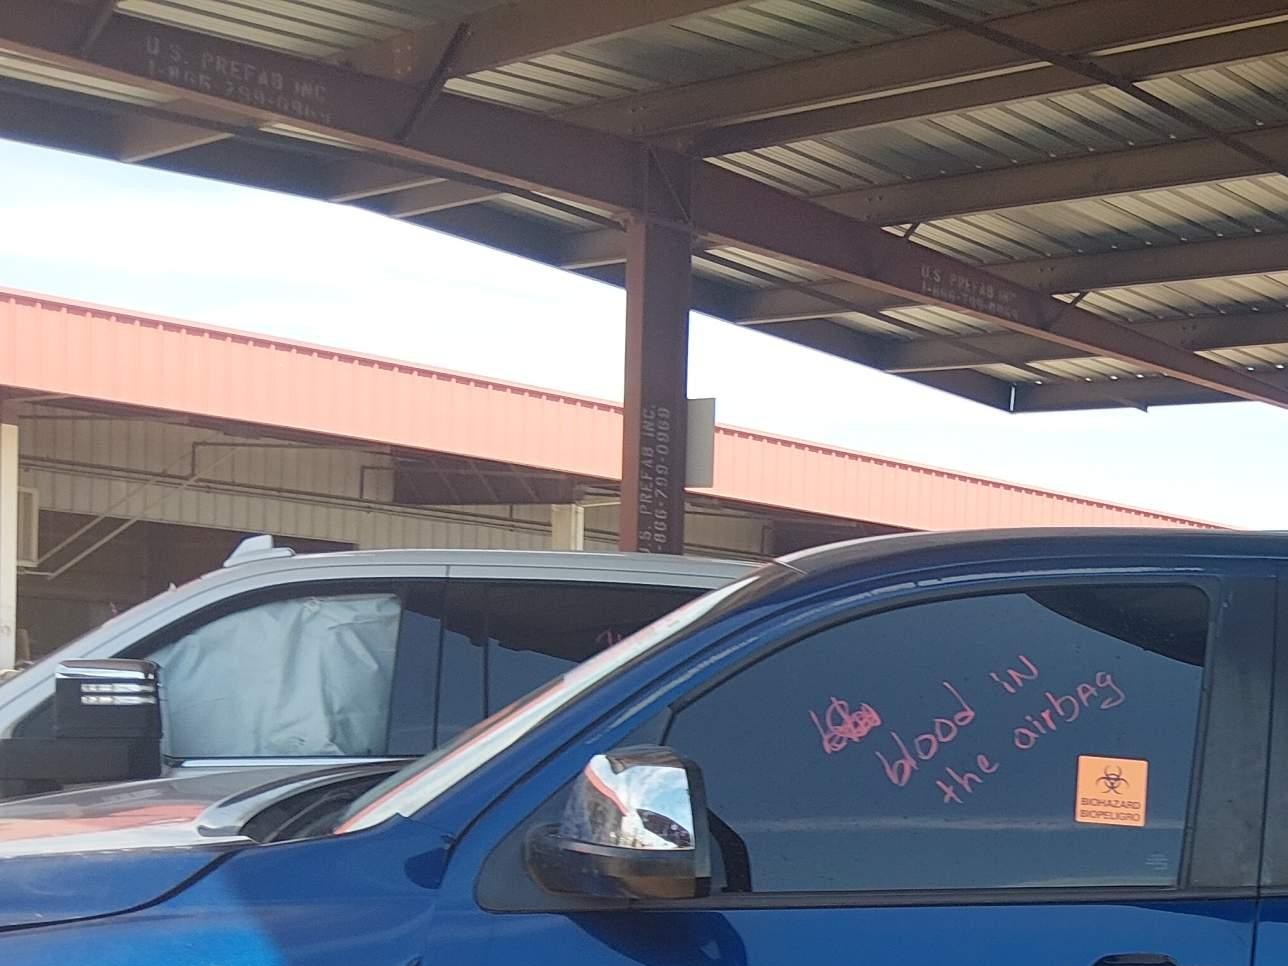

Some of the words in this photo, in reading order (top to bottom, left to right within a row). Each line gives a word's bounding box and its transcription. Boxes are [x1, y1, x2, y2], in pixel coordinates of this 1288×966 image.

[639, 446, 655, 515] PREFAB
[876, 681, 976, 787] blood
[936, 754, 999, 803] the
[1080, 797, 1142, 810] BIOHAZARD
[1080, 809, 1141, 822] BIOPELIGRO
